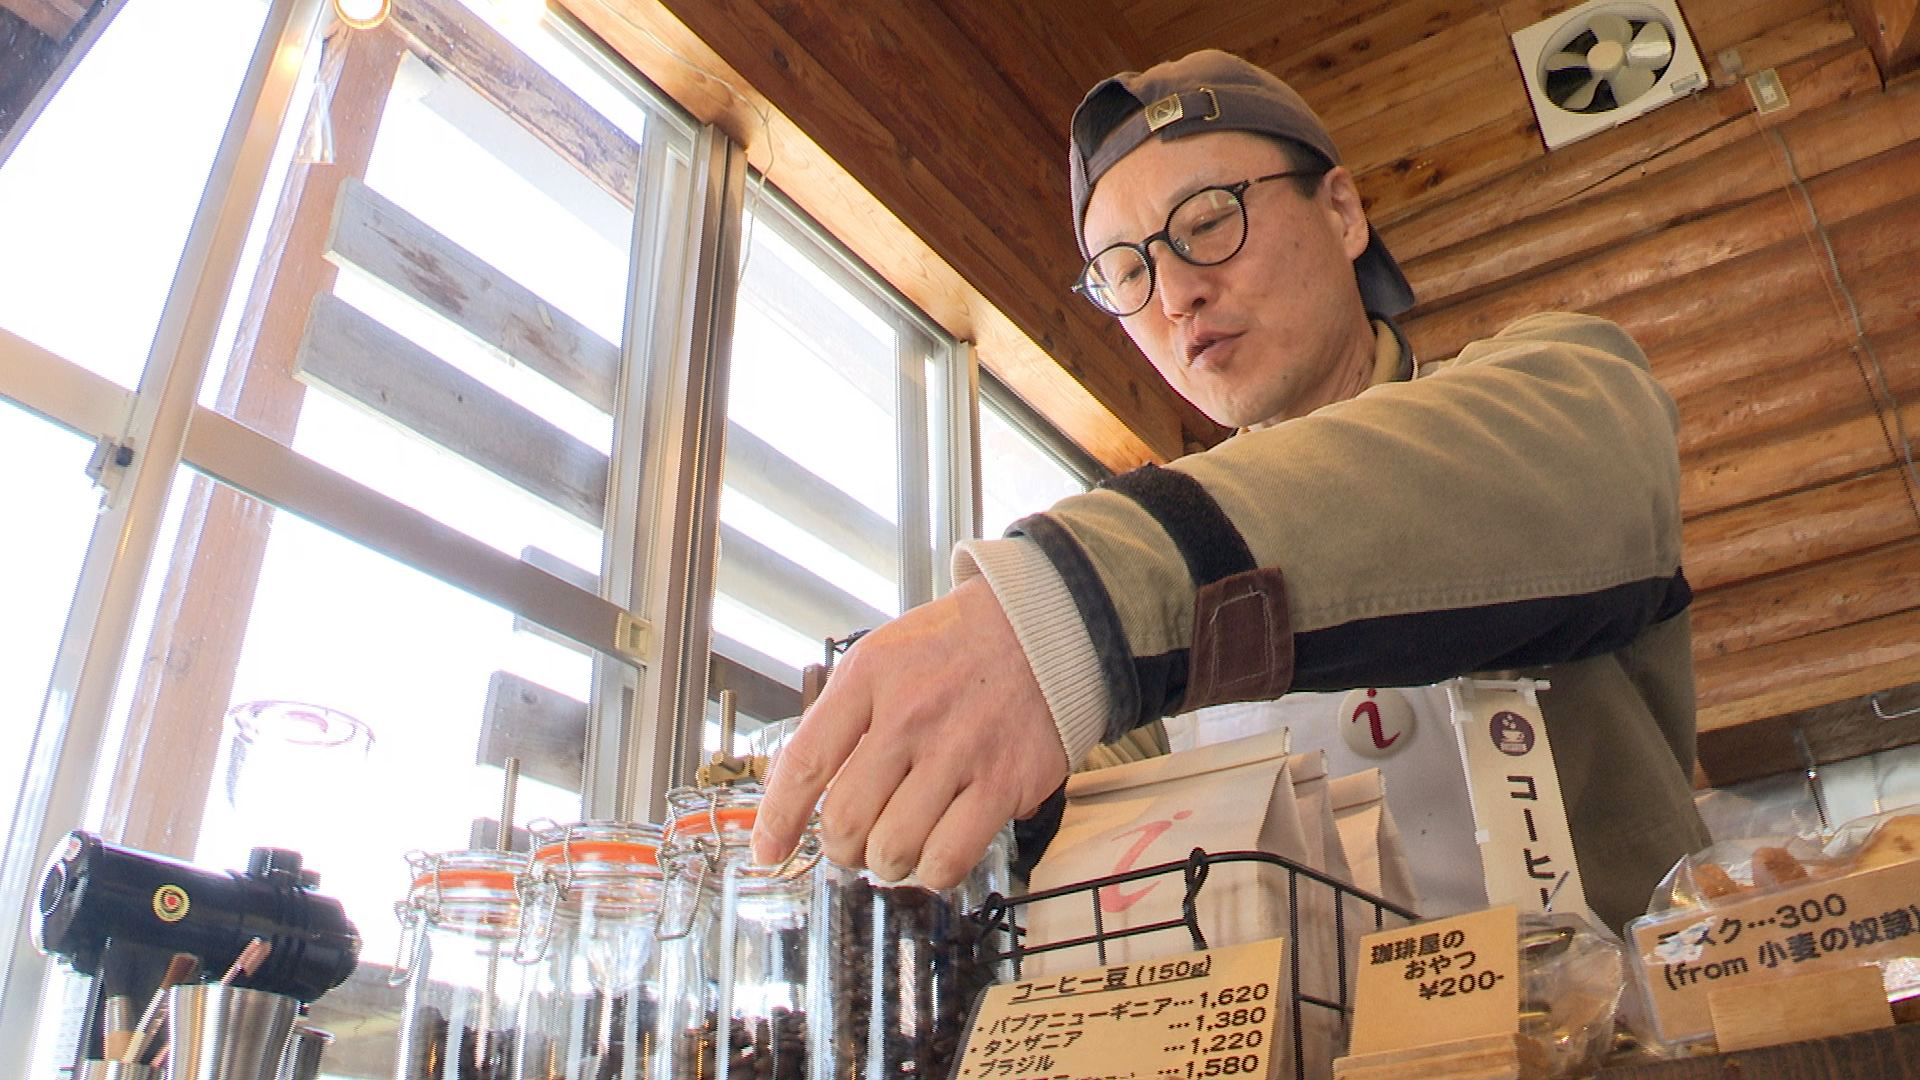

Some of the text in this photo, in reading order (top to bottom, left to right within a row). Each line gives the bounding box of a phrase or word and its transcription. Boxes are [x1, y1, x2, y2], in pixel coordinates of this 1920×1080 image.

[1370, 929, 1466, 966] 珈琲屋の
[1404, 950, 1477, 981] おやつ
[1664, 956, 1749, 991] (from
